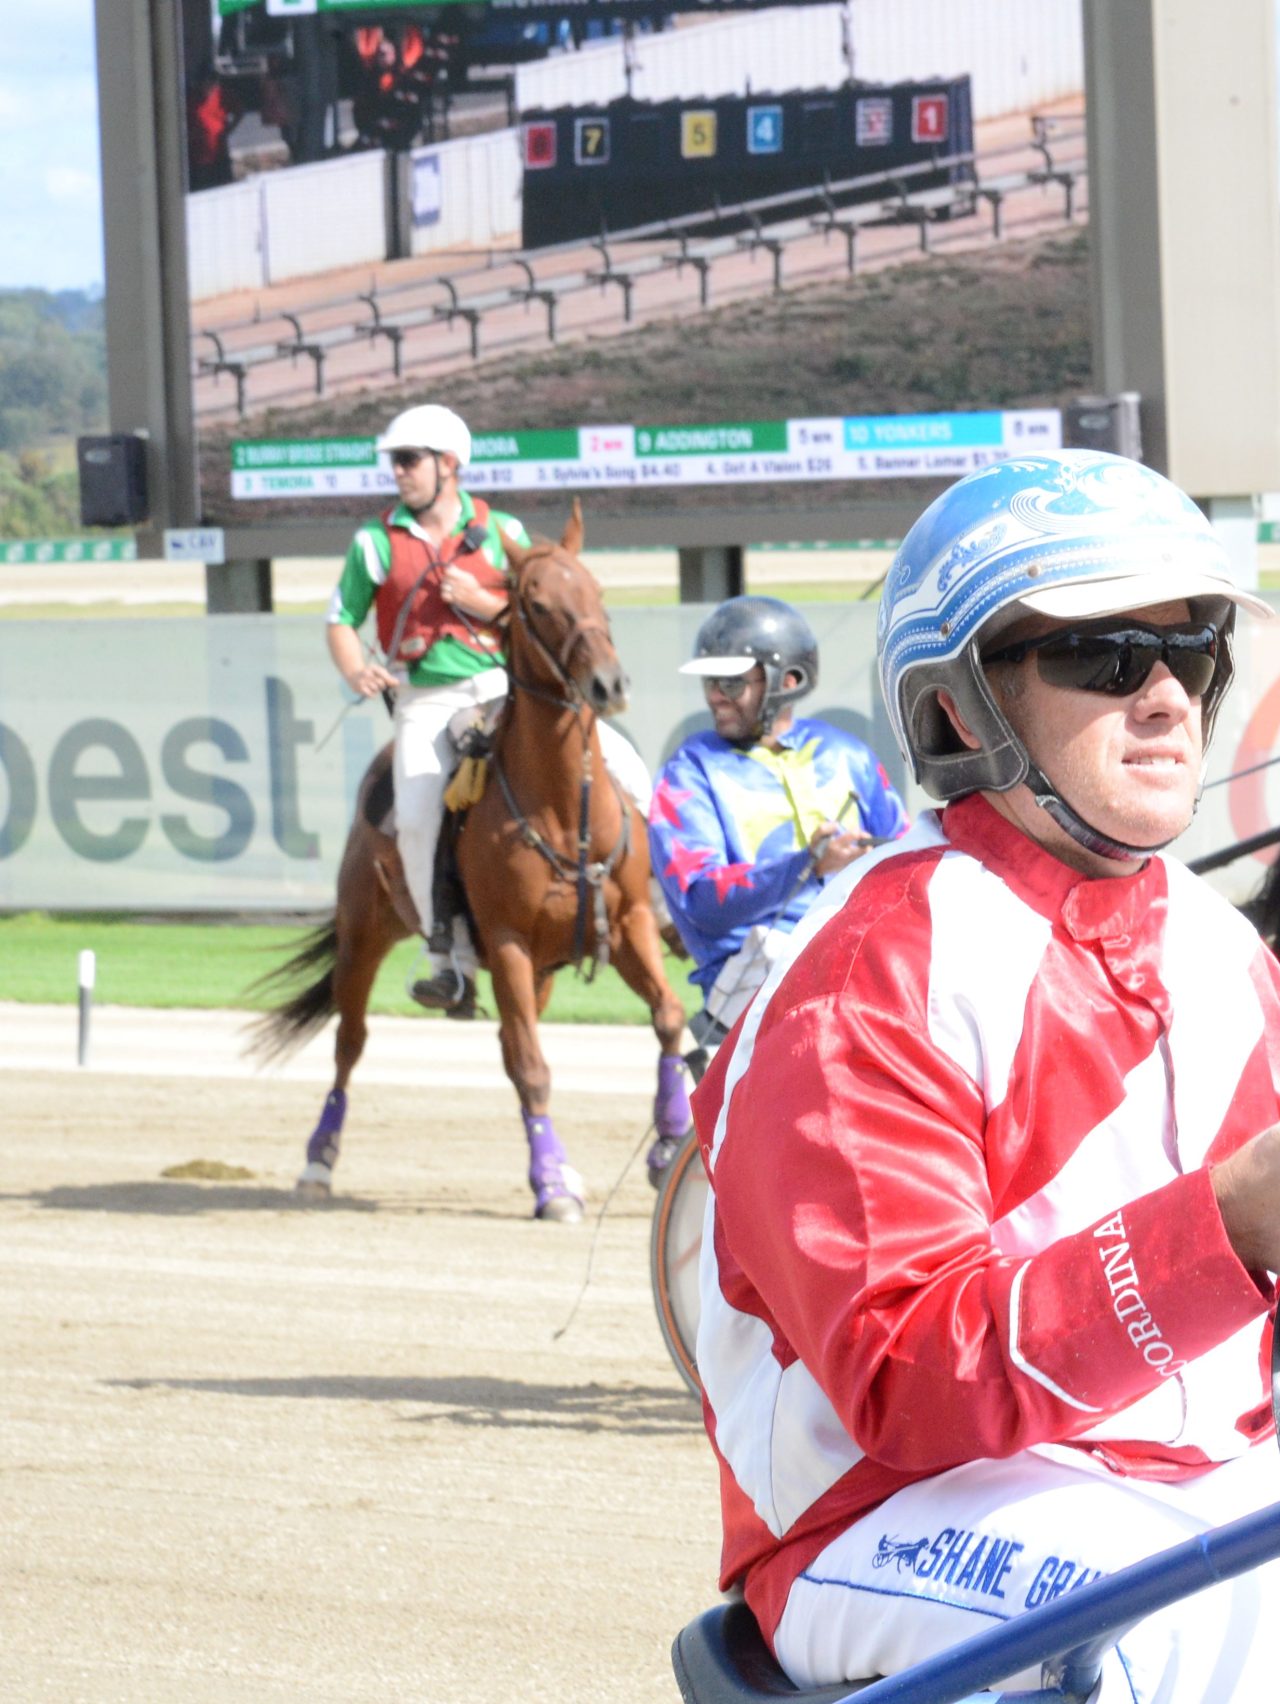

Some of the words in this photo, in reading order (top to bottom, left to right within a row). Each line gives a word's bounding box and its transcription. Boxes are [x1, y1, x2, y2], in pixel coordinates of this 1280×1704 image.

[585, 127, 602, 155] 7
[691, 122, 707, 147] 5
[755, 118, 774, 143] 4
[923, 104, 938, 133] 1
[471, 436, 520, 458] MORA
[638, 431, 652, 453] 9
[655, 428, 754, 451] ADDINGTON
[915, 1527, 1025, 1599] SHANE
